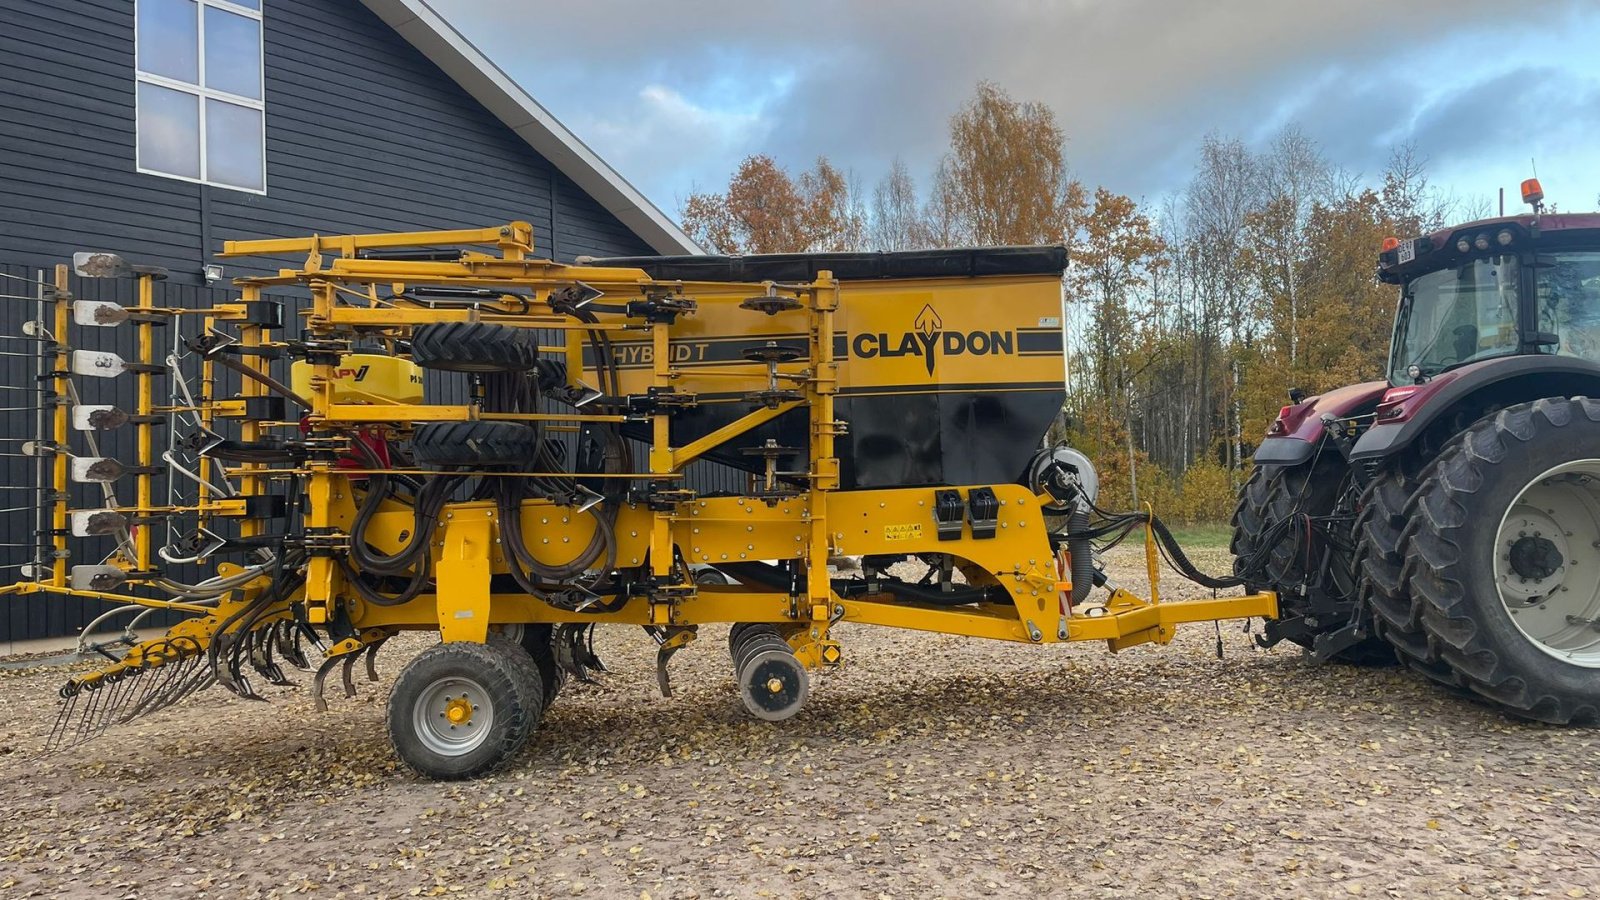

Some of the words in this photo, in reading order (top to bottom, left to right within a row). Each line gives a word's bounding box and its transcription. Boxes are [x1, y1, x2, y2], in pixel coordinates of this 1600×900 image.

[612, 344, 692, 363] HYBID
[695, 343, 709, 361] T
[853, 331, 1013, 377] CLAYDON
